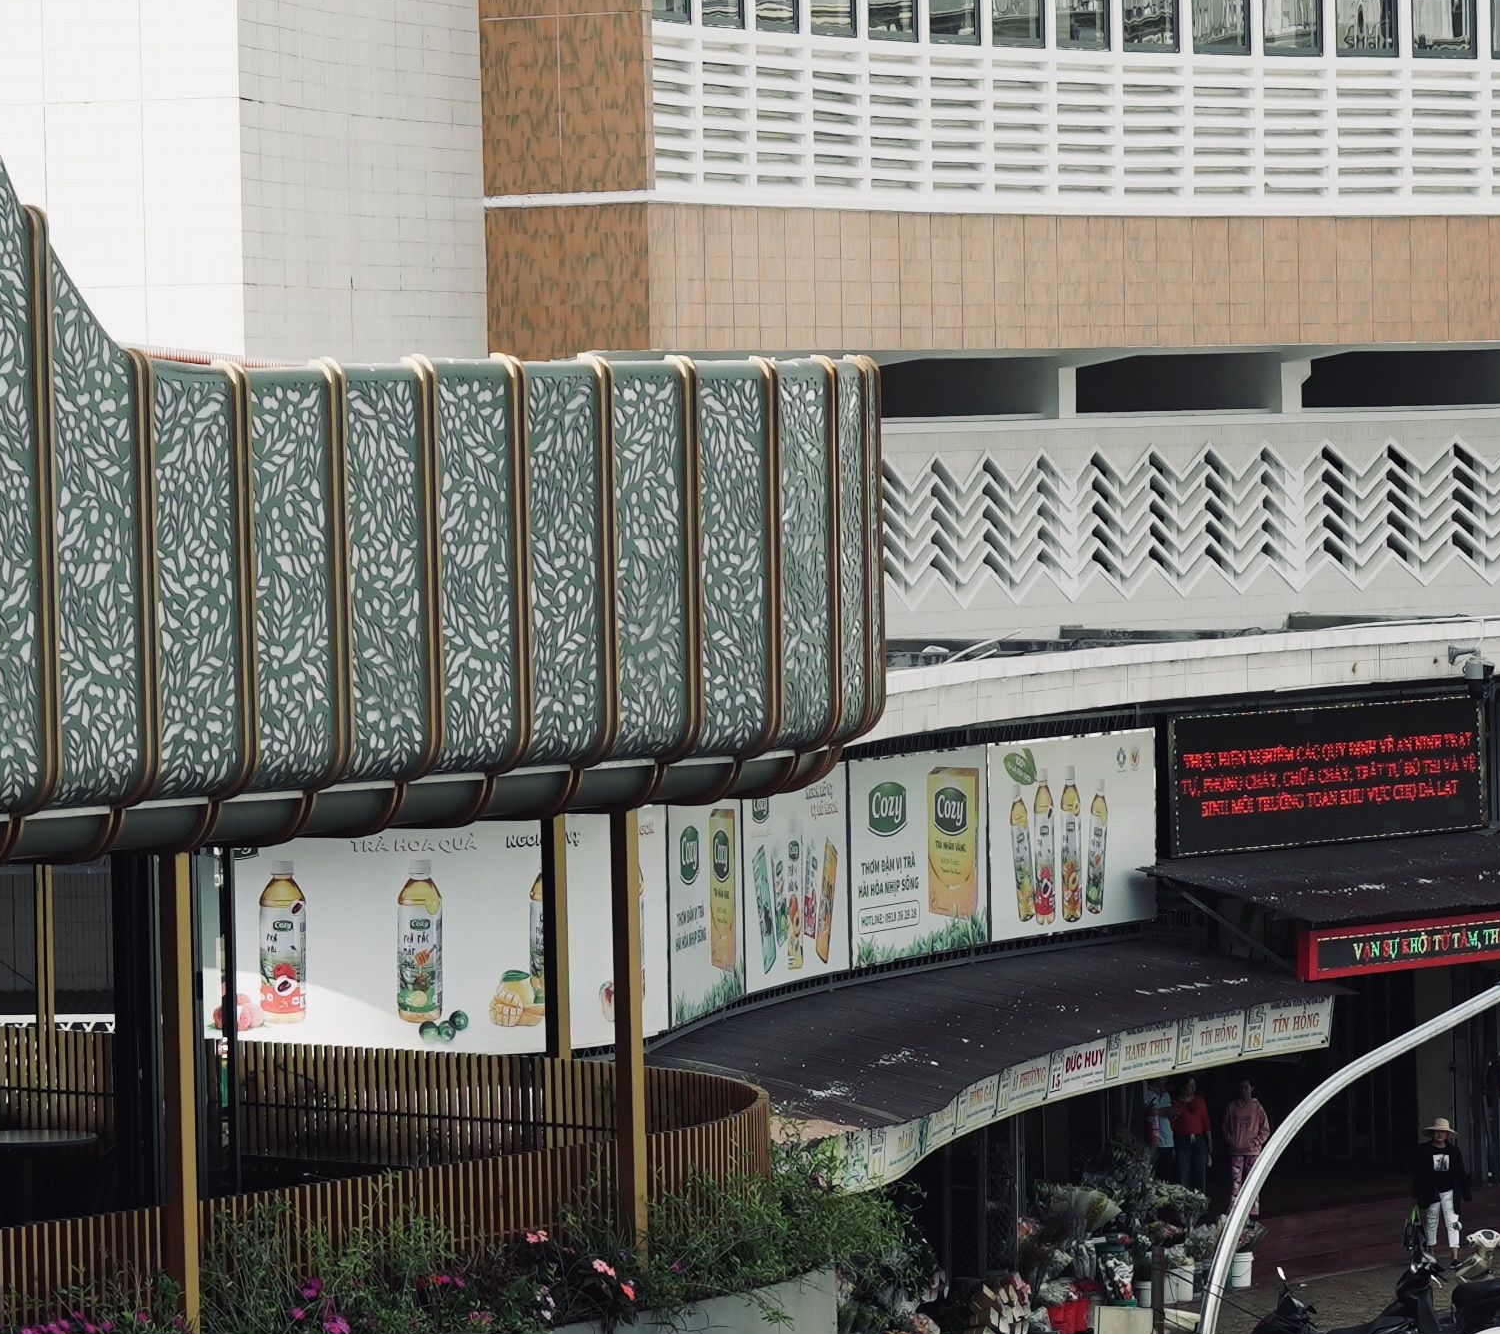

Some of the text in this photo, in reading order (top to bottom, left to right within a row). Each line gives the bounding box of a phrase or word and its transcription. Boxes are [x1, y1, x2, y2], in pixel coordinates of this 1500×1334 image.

[871, 791, 904, 823] Cozy
[937, 794, 965, 826] Cozy
[1353, 940, 1380, 961] VẠN
[1382, 937, 1399, 959] SỰ
[1065, 1048, 1105, 1074] ĐỨC HUY
[1051, 1074, 1061, 1089] 15
